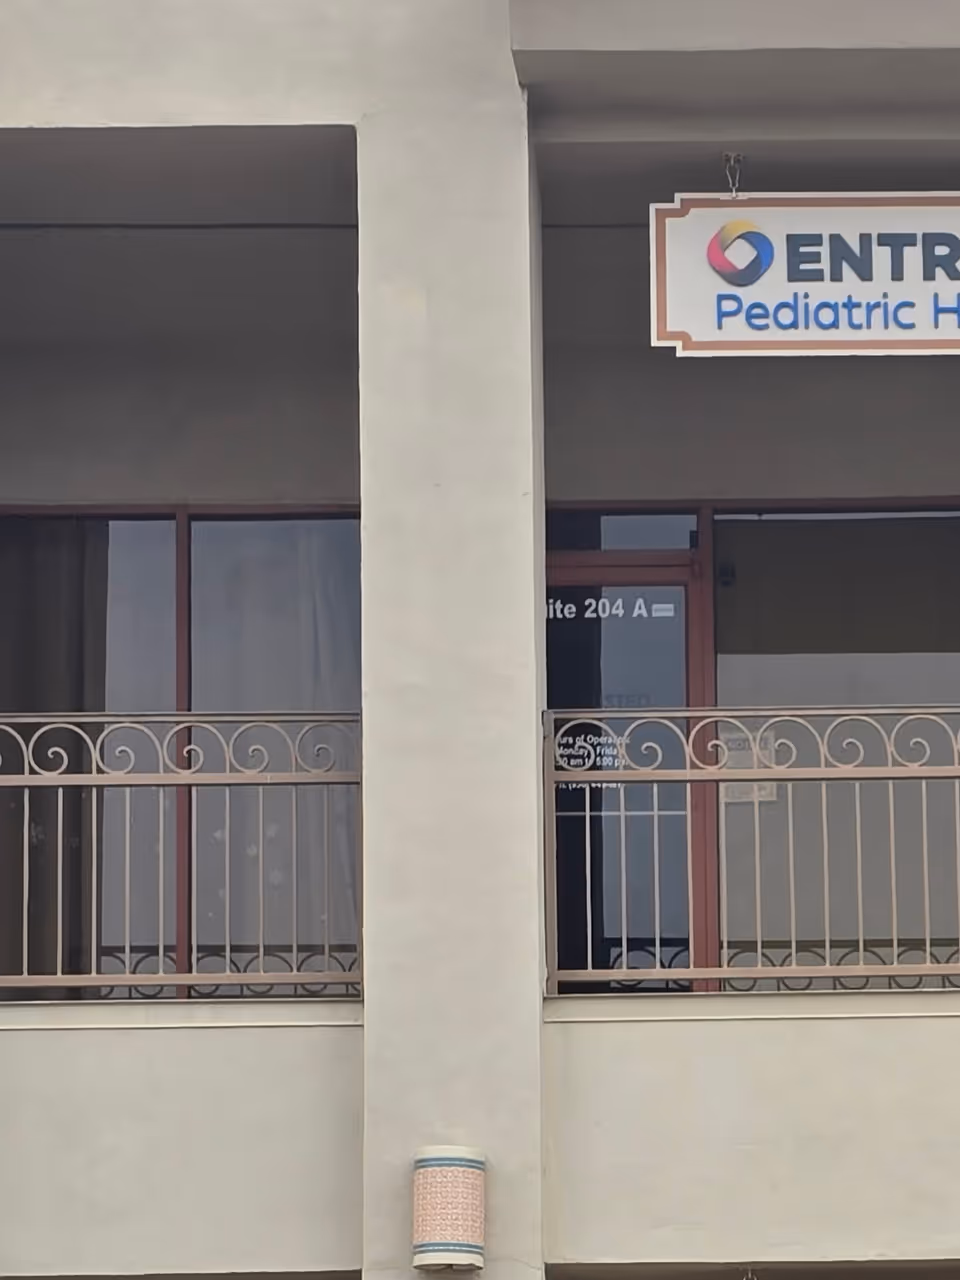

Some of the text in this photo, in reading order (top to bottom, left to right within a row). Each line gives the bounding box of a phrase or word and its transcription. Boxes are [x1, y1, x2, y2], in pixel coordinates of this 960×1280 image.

[716, 292, 917, 331] Pediatric
[545, 597, 648, 619] ite 204 A
